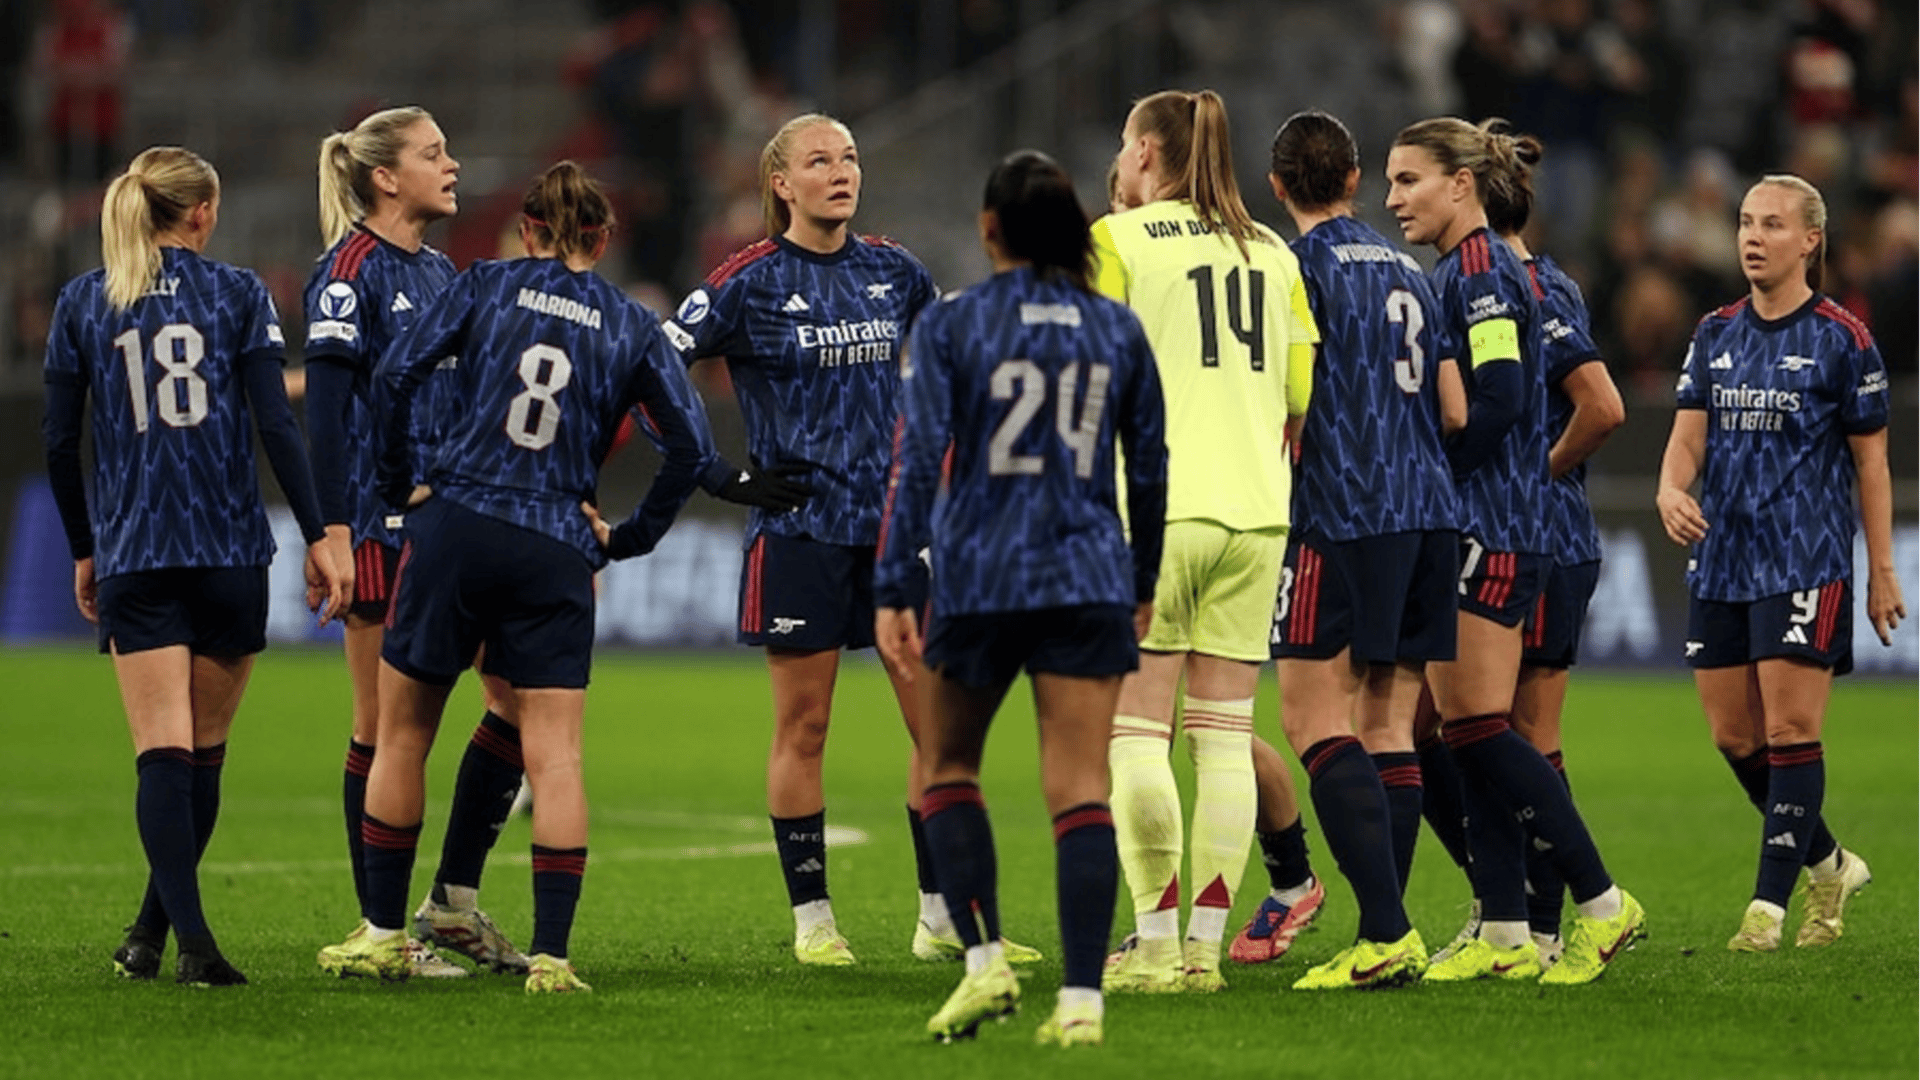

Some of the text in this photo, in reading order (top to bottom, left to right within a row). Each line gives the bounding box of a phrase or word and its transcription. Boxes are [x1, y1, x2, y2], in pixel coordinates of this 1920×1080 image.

[1144, 220, 1183, 239] VAN
[516, 287, 602, 330] MARIONA
[796, 318, 898, 348] Emirates
[1186, 264, 1265, 373] 14
[1386, 289, 1425, 394] 3
[113, 323, 208, 434] 18
[819, 341, 892, 368] FLY BETTER
[505, 342, 572, 451] 8
[988, 358, 1112, 479] 24
[1711, 383, 1801, 412] Emirates
